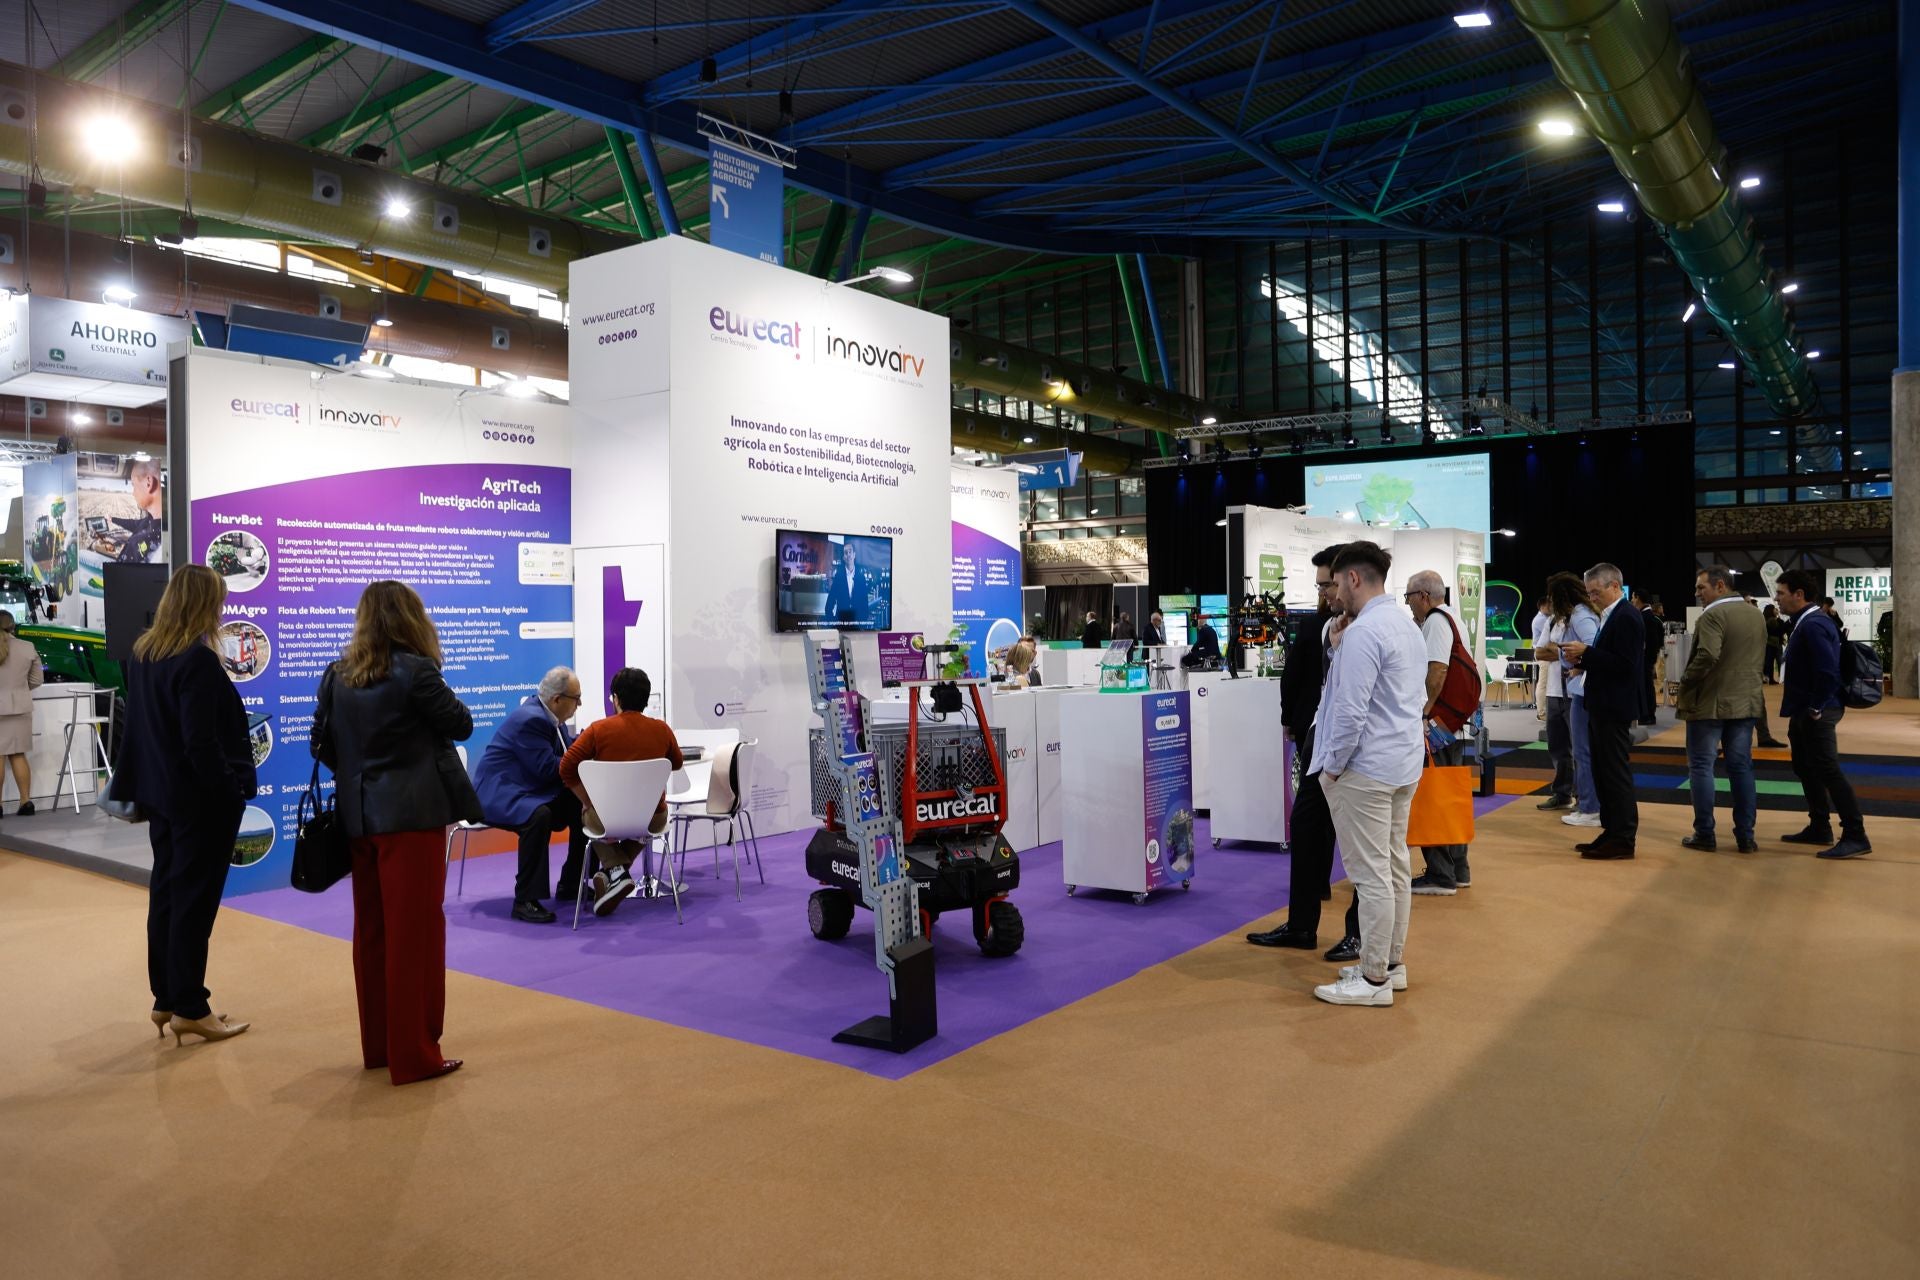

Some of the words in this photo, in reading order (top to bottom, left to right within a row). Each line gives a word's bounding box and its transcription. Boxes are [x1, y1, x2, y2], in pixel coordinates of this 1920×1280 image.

[713, 150, 760, 173] AUDITORIUM
[713, 160, 754, 181] ANDALUCÍA
[713, 170, 751, 190] AGROTECH
[760, 252, 778, 264] AULA
[583, 302, 655, 326] www.eurecat.org
[71, 321, 156, 348] AHORRO
[91, 344, 136, 357] ESSENTIALS
[482, 419, 534, 432] www.eurecat.org
[730, 415, 786, 435] Innovando
[790, 428, 806, 438] con
[809, 428, 822, 441] las
[824, 433, 868, 448] empresas
[870, 438, 883, 450] del
[885, 442, 910, 454] sector
[724, 436, 766, 452] agrícola
[769, 444, 781, 453] en
[784, 443, 854, 466] Sostenibilidad,
[856, 455, 916, 475] Biotecnología,
[748, 458, 794, 474] Robótica
[796, 466, 802, 475] e
[804, 466, 859, 483] Inteligencia
[861, 475, 899, 487] Artificial
[1039, 465, 1045, 474] 2
[1055, 467, 1064, 484] 1
[482, 478, 541, 495] AgriTech
[420, 492, 494, 511] Investigación
[498, 498, 541, 513] aplicada
[212, 513, 262, 525] HarvBot
[742, 514, 798, 528] www.eurecat.org
[277, 518, 322, 529] Recolección
[324, 521, 374, 531] automatizada
[376, 522, 384, 531] de
[386, 524, 404, 532] fruta
[405, 524, 436, 533] mediante
[438, 526, 458, 534] robots
[460, 528, 501, 537] colaborativos
[502, 530, 506, 538] y
[285, 539, 312, 548] proyecto
[314, 539, 338, 547] HarvBot
[339, 541, 364, 549] presenta
[396, 542, 418, 550] robótico
[419, 543, 437, 551] guiado
[278, 547, 312, 556] inteligencia
[314, 547, 338, 556] artificial
[339, 549, 349, 558] que
[351, 548, 374, 557] combina
[376, 550, 398, 558] diversas
[400, 551, 429, 559] tecnologías
[474, 553, 489, 561] lograr
[432, 560, 465, 568] identificación
[278, 566, 302, 575] espacial
[322, 567, 342, 575] frutos,
[459, 569, 480, 577] recogida
[318, 576, 333, 585] pinza
[335, 576, 367, 585] optimizada
[1835, 576, 1873, 589] AREA
[1879, 576, 1891, 588] D
[278, 585, 300, 593] tiempo
[299, 606, 308, 614] de
[310, 606, 336, 614] Robots
[502, 606, 528, 615] Agrícolas
[448, 629, 480, 637] pulverización
[288, 651, 310, 659] gestión
[484, 653, 509, 661] asignación
[280, 695, 313, 703] Sistemas
[472, 686, 500, 694] orgánicos
[287, 716, 314, 724] proyecto
[281, 724, 311, 733] orgánicos
[281, 735, 308, 744] agrícolas
[917, 793, 1000, 822] eurecat
